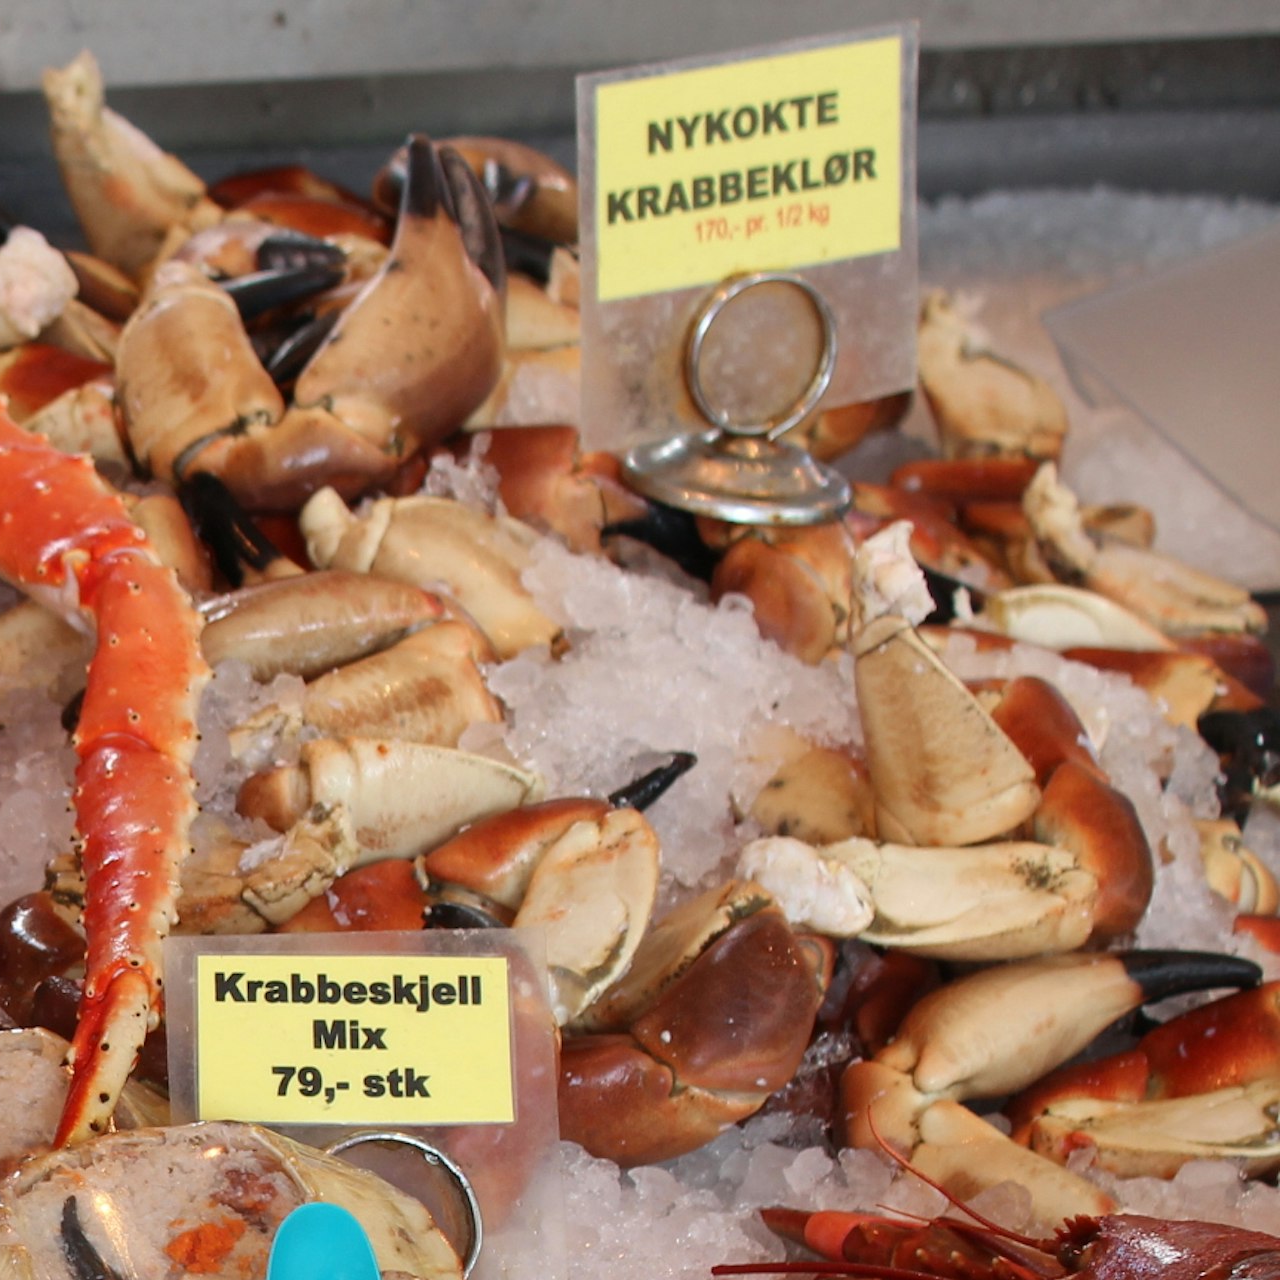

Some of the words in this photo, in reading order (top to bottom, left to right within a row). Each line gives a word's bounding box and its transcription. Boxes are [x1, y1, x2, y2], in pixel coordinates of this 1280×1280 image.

[648, 90, 839, 155] NYKOKTE
[607, 147, 877, 225] KRABBEKLØR
[695, 217, 741, 243] 170,-
[777, 203, 802, 230] 1/2
[809, 202, 830, 228] kg
[214, 972, 481, 1012] Krabbeskjell
[313, 1020, 387, 1050] Mix
[272, 1066, 350, 1103] 79,-
[363, 1068, 431, 1098] stk
